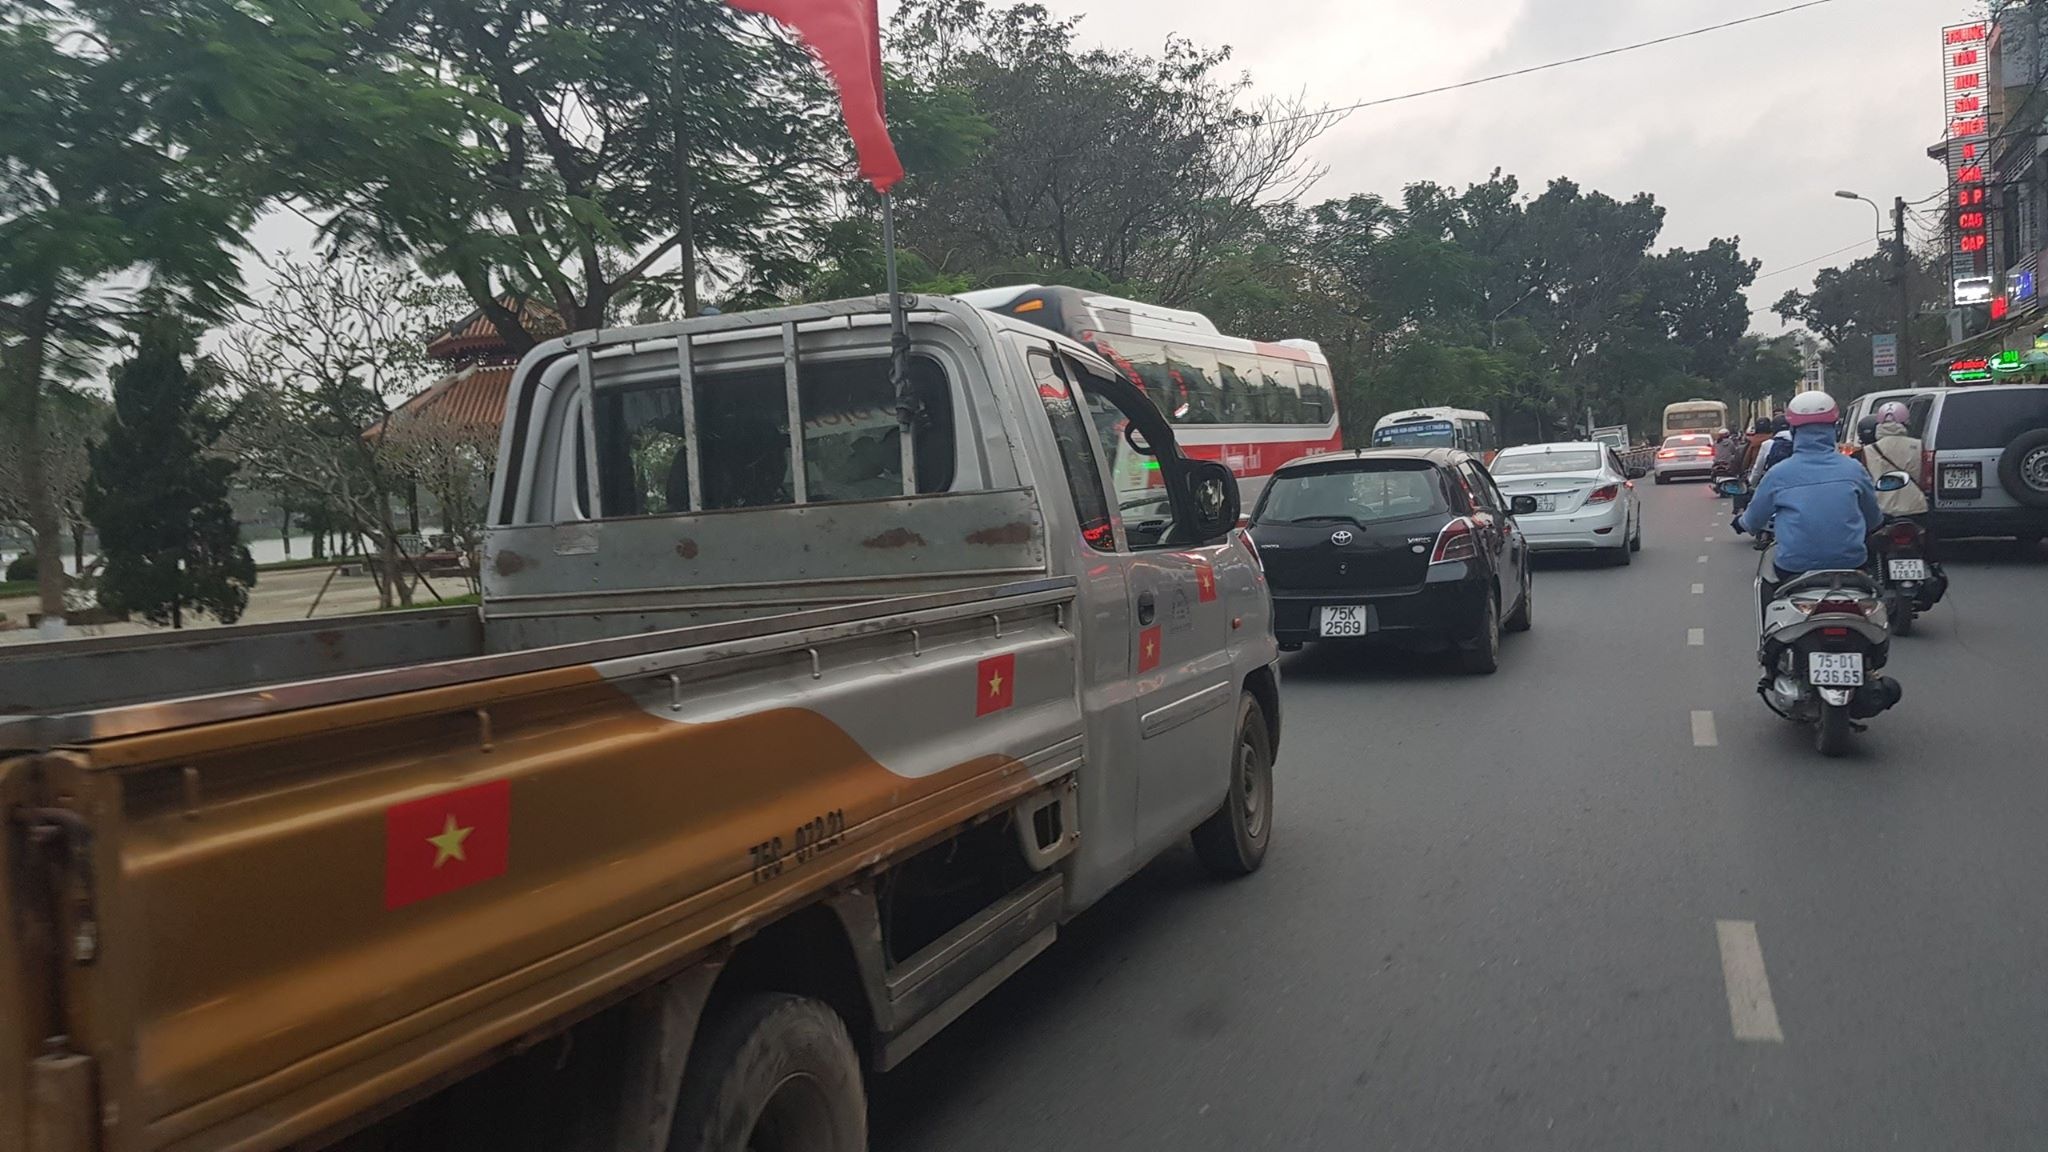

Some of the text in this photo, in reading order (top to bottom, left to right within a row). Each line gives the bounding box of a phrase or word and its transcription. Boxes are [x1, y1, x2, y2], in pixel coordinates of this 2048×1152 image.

[1947, 478, 1973, 488] 5722
[1329, 607, 1357, 621] 75K
[1325, 621, 1361, 636] 2569
[1817, 654, 1855, 669] 75-D1
[1813, 669, 1861, 684] 236.65
